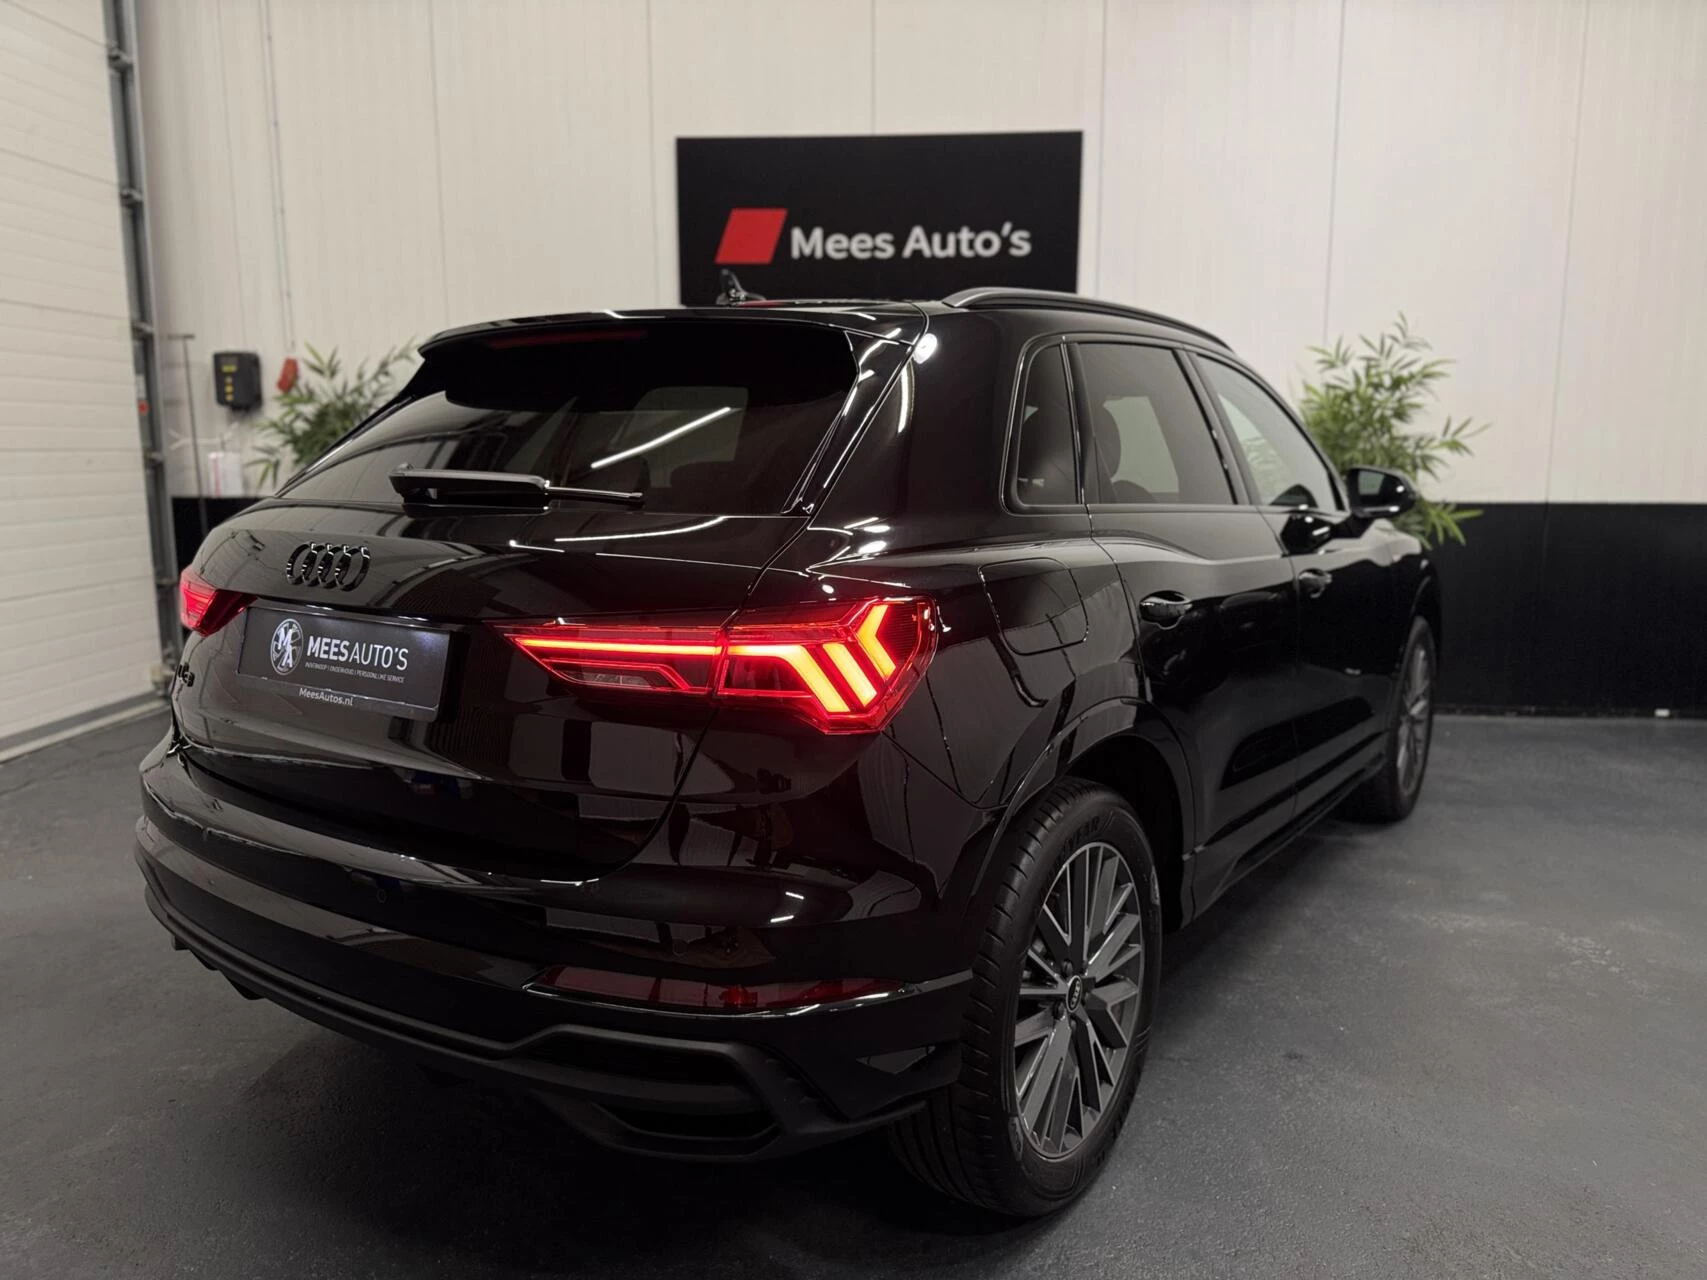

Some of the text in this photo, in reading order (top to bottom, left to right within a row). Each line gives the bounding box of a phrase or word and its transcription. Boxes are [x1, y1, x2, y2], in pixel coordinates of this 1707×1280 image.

[791, 221, 1032, 260] Mees Auto's
[299, 687, 353, 706] MeesAutos.nl
